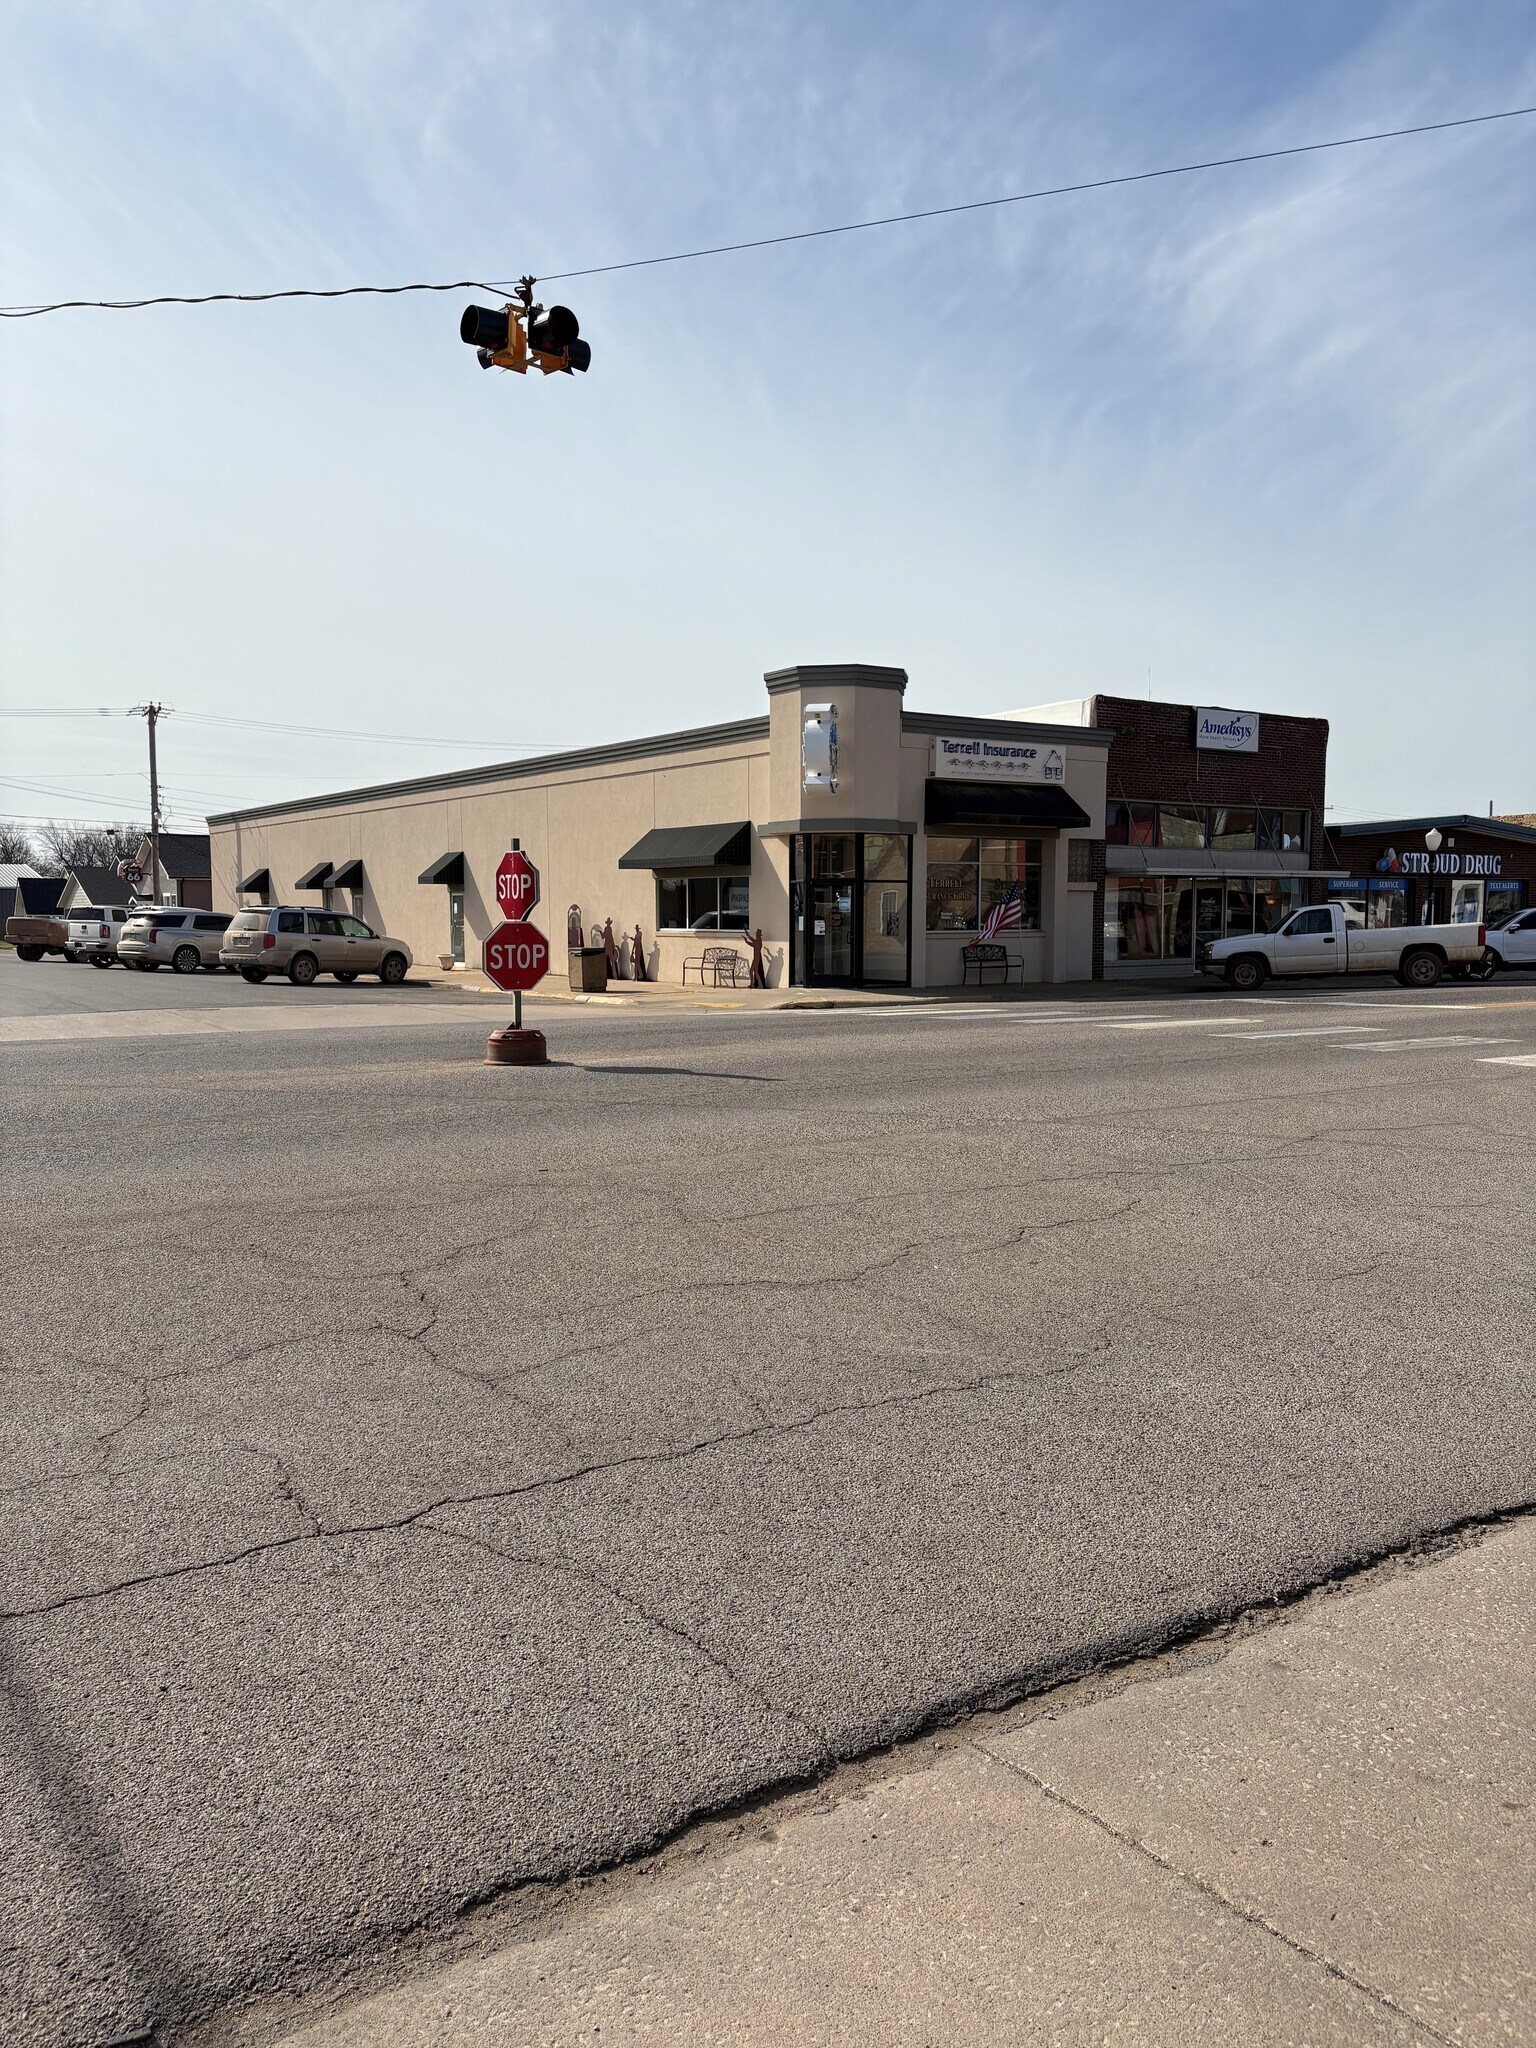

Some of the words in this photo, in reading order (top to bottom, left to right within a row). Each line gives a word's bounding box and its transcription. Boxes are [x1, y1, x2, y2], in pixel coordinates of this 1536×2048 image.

[1200, 718, 1252, 742] Amedisys
[941, 739, 980, 755] Terrell
[983, 742, 1038, 759] Insurance
[1464, 854, 1502, 875] DRUG
[127, 873, 141, 881] 66
[499, 873, 531, 899] STOP
[1332, 880, 1359, 888] SUPERIOR
[1378, 880, 1399, 889] SERVICE
[490, 944, 545, 969] STOP
